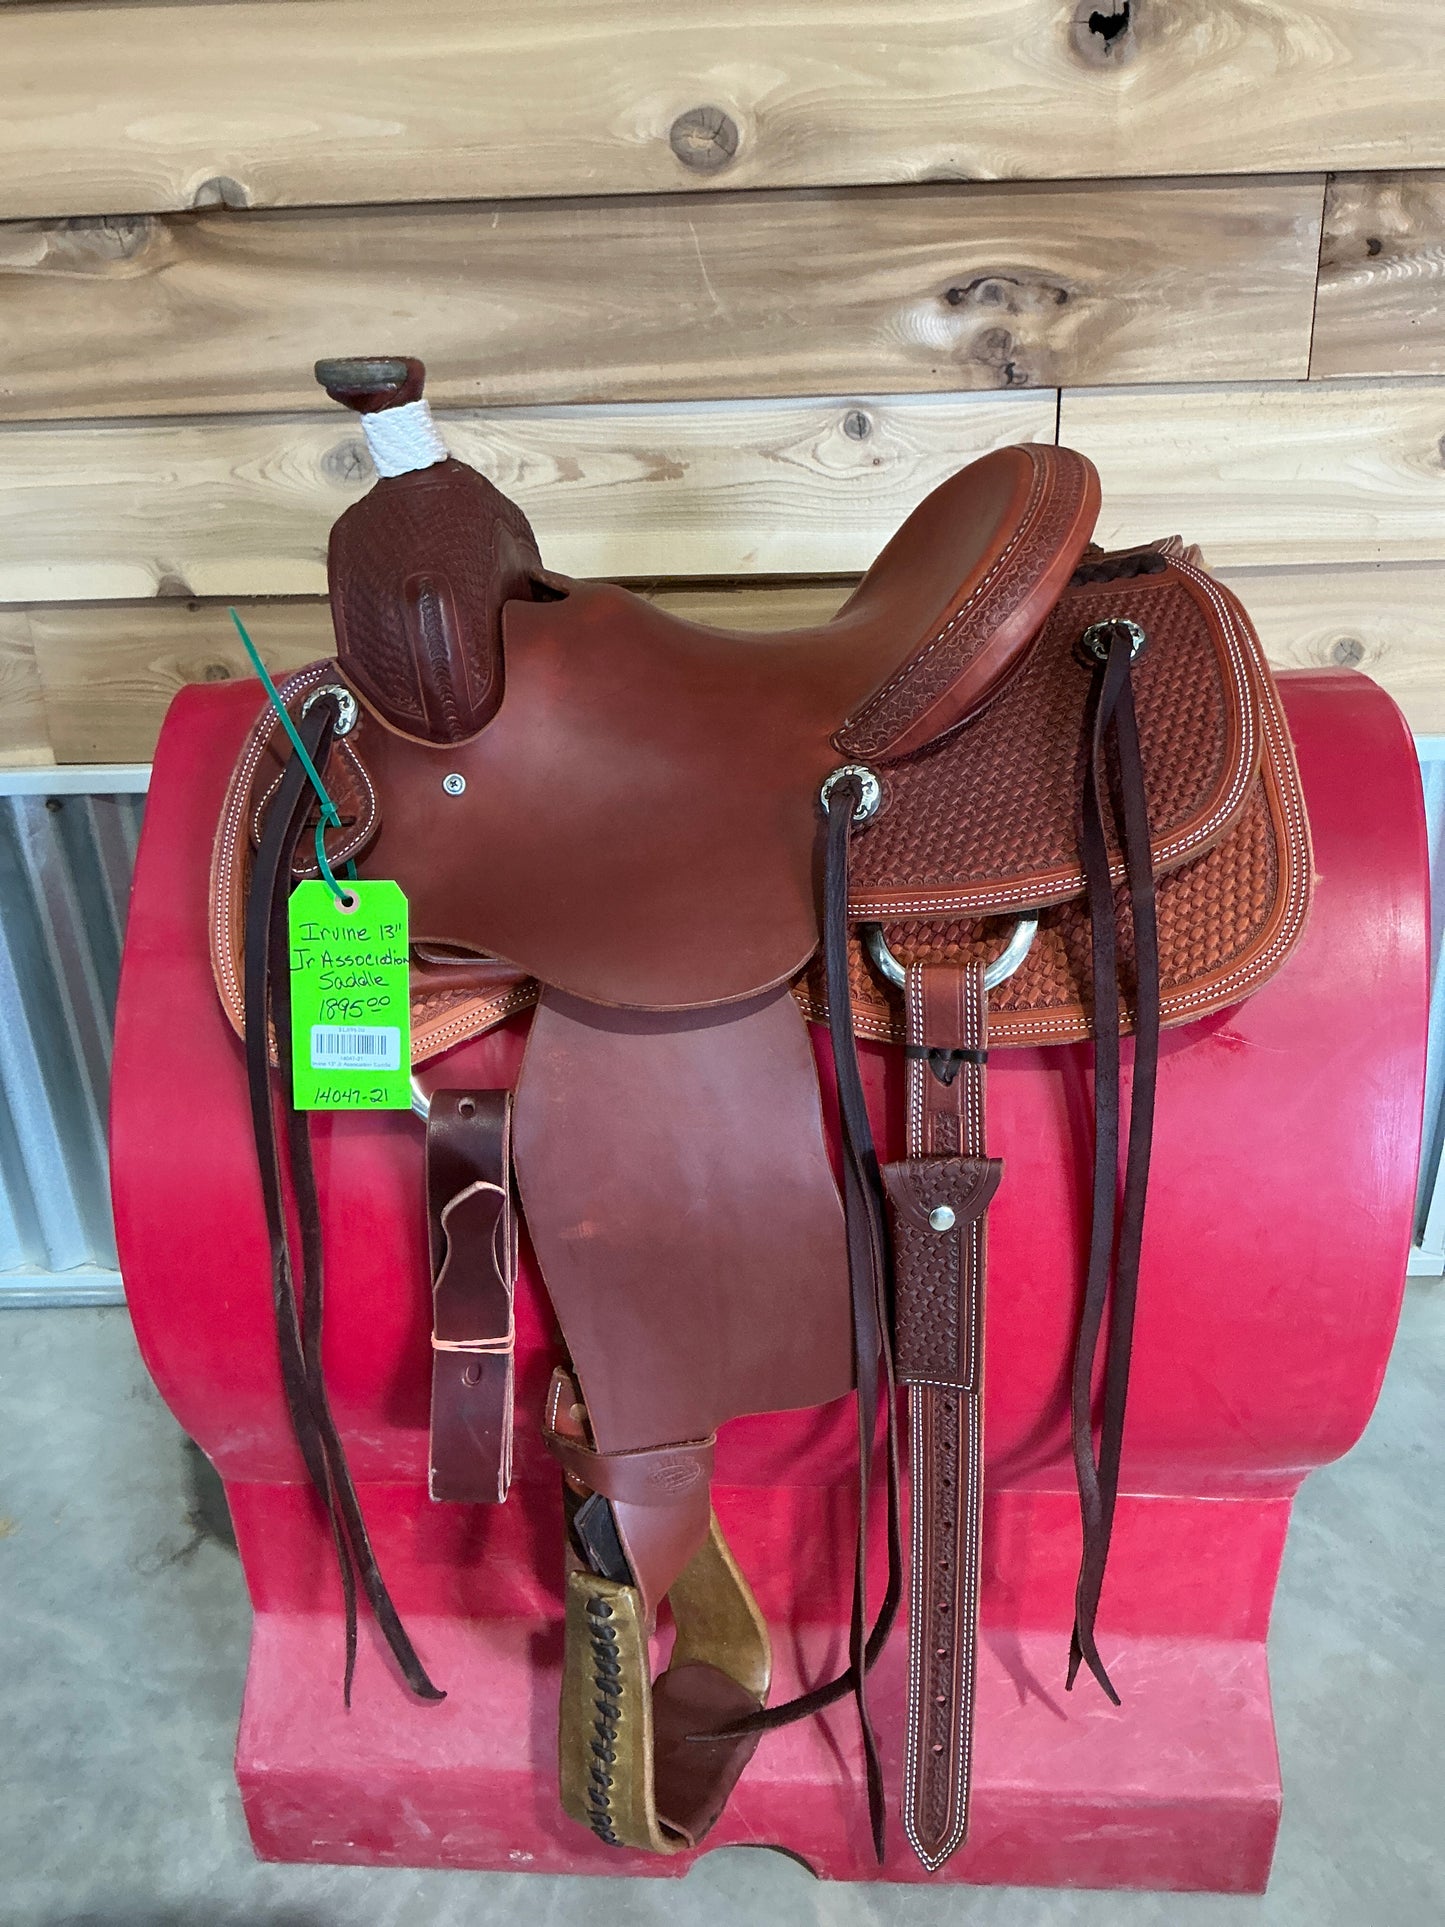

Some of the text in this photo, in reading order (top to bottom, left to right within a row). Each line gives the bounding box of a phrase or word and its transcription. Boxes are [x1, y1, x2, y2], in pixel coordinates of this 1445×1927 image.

[299, 923, 371, 941] Irvine
[290, 948, 409, 971] Jr Association
[318, 971, 389, 990] Saddle
[314, 1087, 388, 1104] 14047-21
